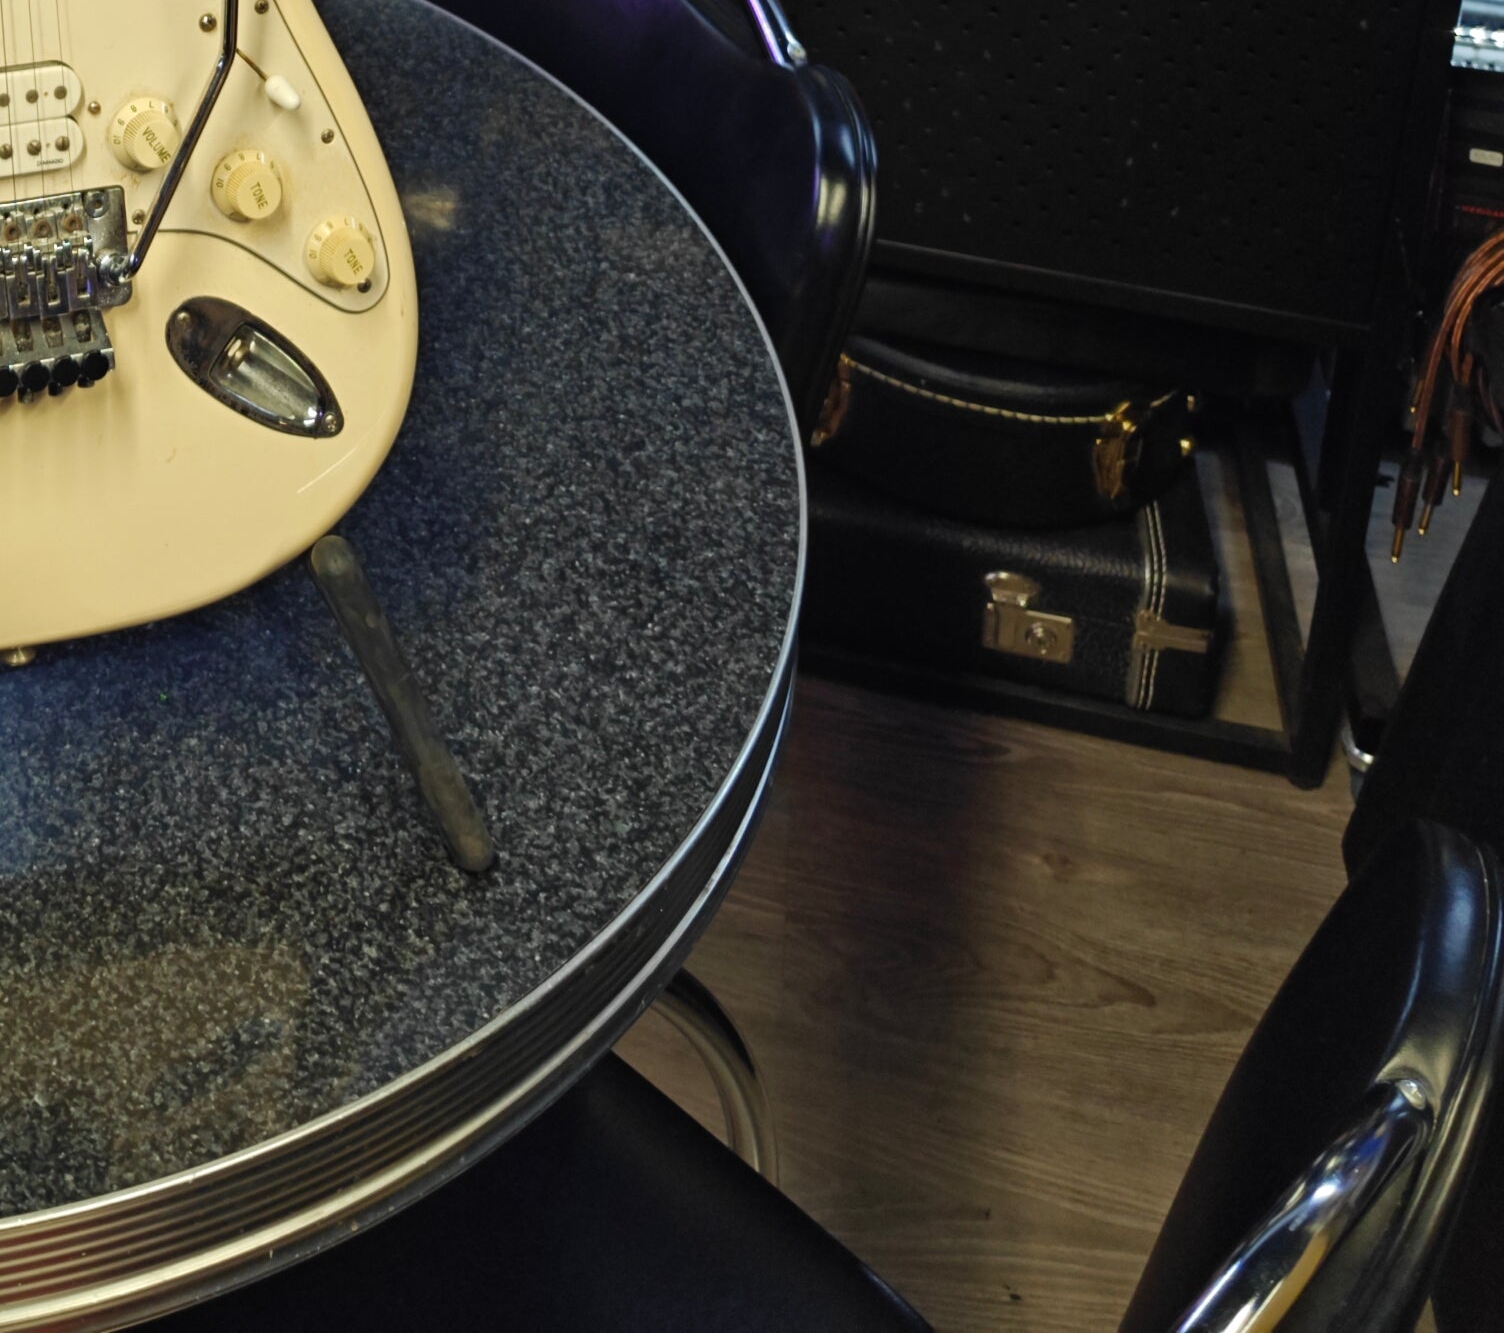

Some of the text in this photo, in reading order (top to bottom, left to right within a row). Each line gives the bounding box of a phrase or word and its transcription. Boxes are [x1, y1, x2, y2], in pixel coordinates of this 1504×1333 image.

[142, 126, 171, 163] VOLUME
[250, 182, 268, 210] TONE
[344, 249, 363, 275] TONE
